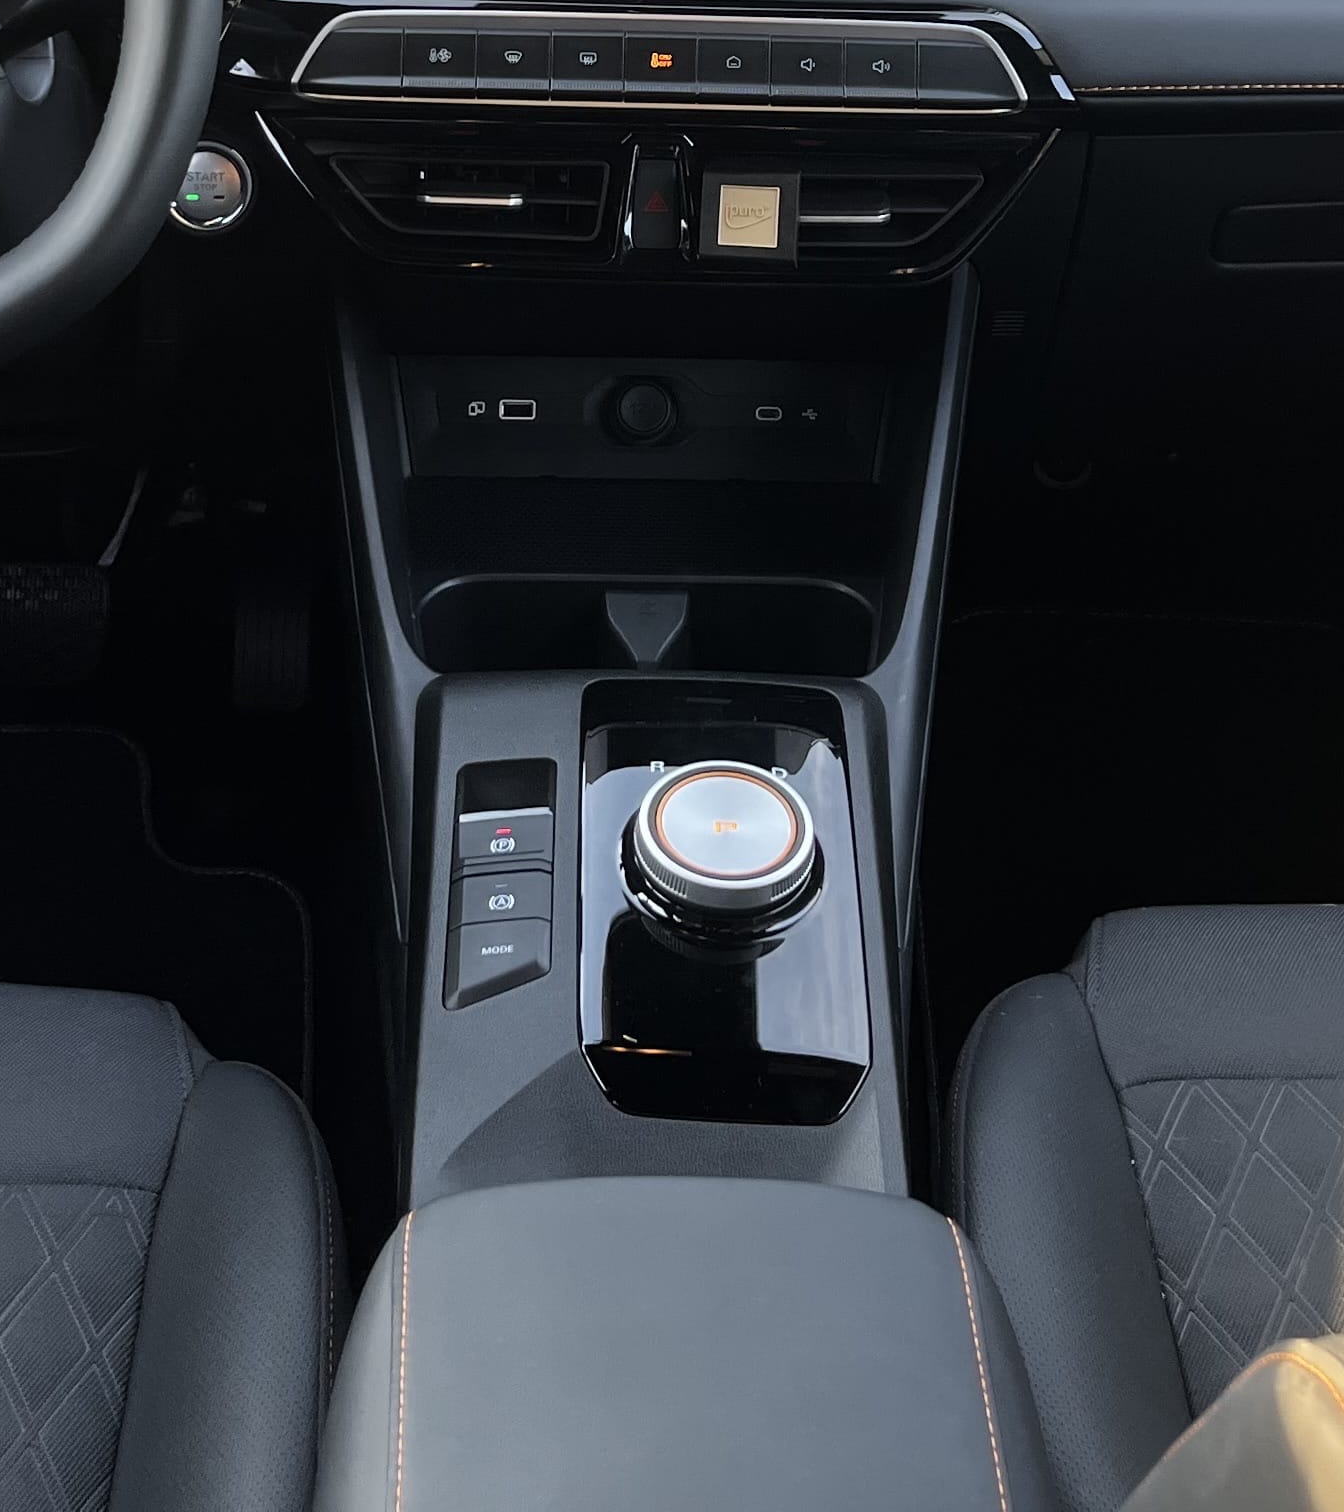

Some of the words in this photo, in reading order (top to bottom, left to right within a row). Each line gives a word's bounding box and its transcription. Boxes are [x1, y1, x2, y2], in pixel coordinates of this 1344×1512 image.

[186, 171, 226, 183] START
[650, 760, 665, 773] R
[480, 945, 515, 956] MODE
